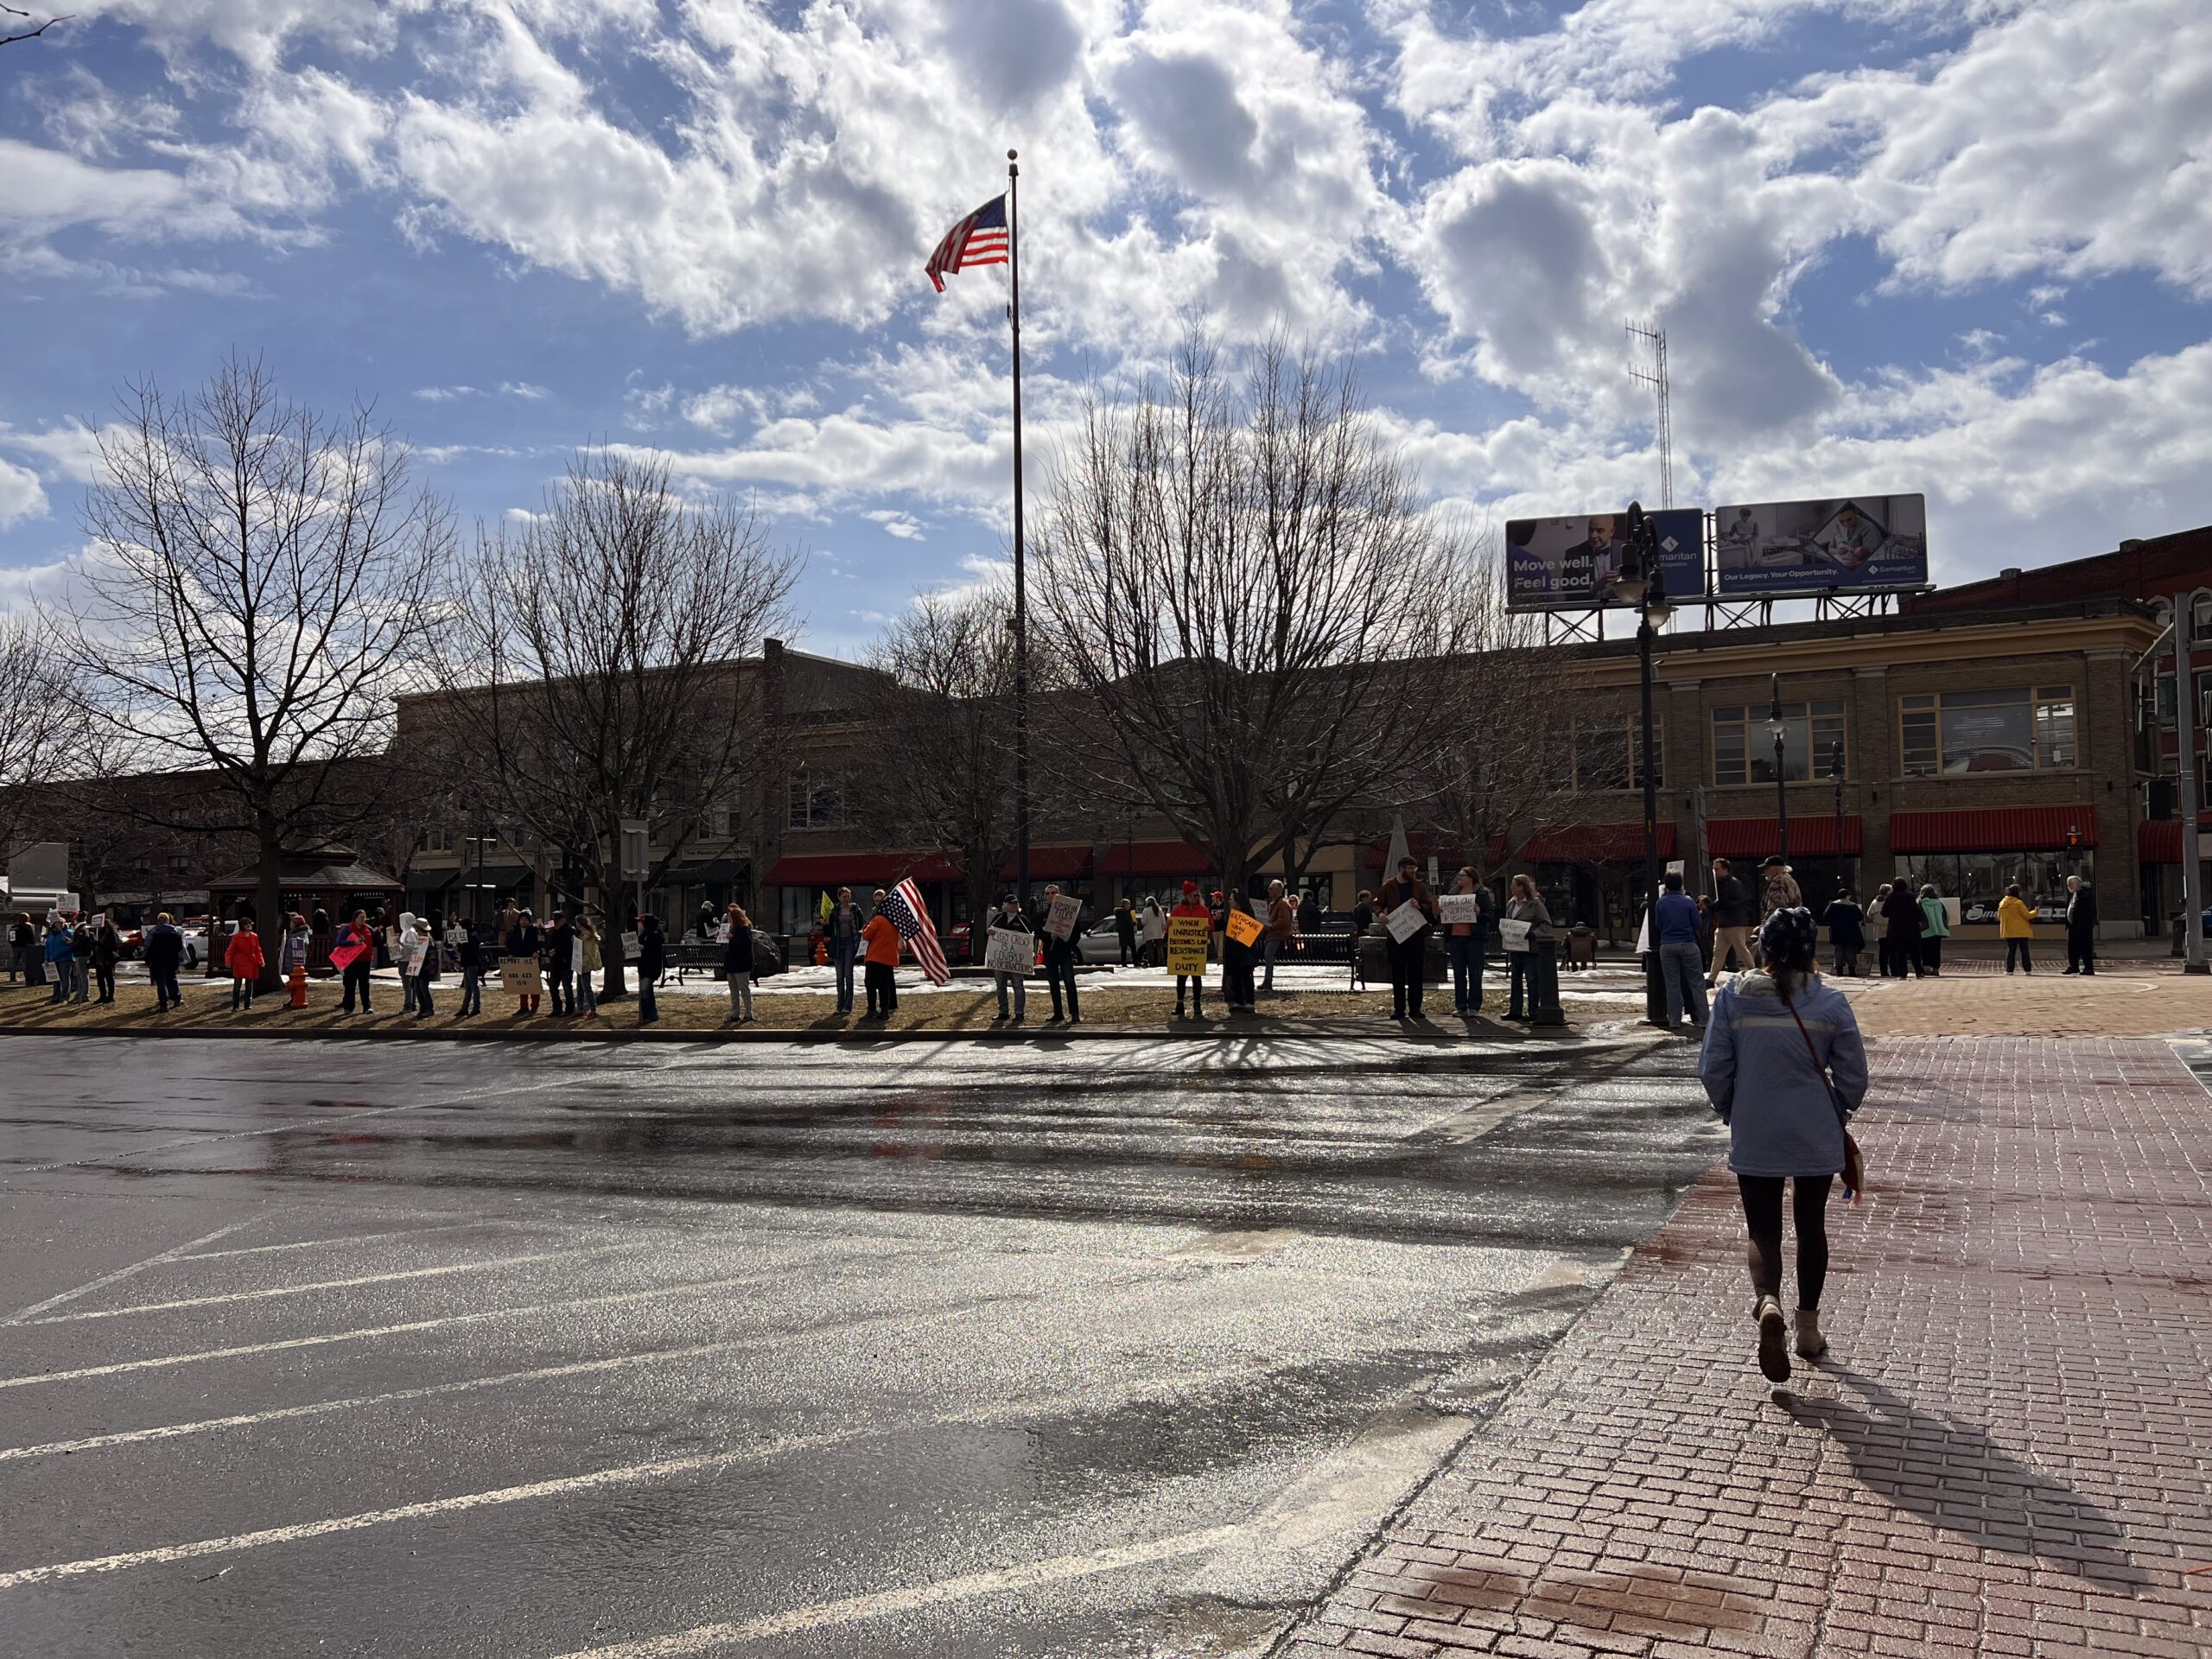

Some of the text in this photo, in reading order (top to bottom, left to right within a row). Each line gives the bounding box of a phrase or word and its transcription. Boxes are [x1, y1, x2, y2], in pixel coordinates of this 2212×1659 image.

[1658, 552, 1697, 562] maritan
[1514, 556, 1594, 571] Move well.
[1514, 573, 1594, 589] Feel good.
[1739, 572, 1770, 582] Legacy.
[1789, 569, 1839, 578] Opportunity.
[1054, 901, 1078, 913] EPSTEIN
[1055, 908, 1072, 920] FILES
[992, 931, 1029, 946] EVERY CRISIS
[1173, 928, 1206, 937] INJUSTICE
[1001, 942, 1015, 954] IS A
[1169, 946, 1205, 955] RESISTANCE
[988, 959, 996, 969] NO
[1175, 963, 1198, 972] DUTY
